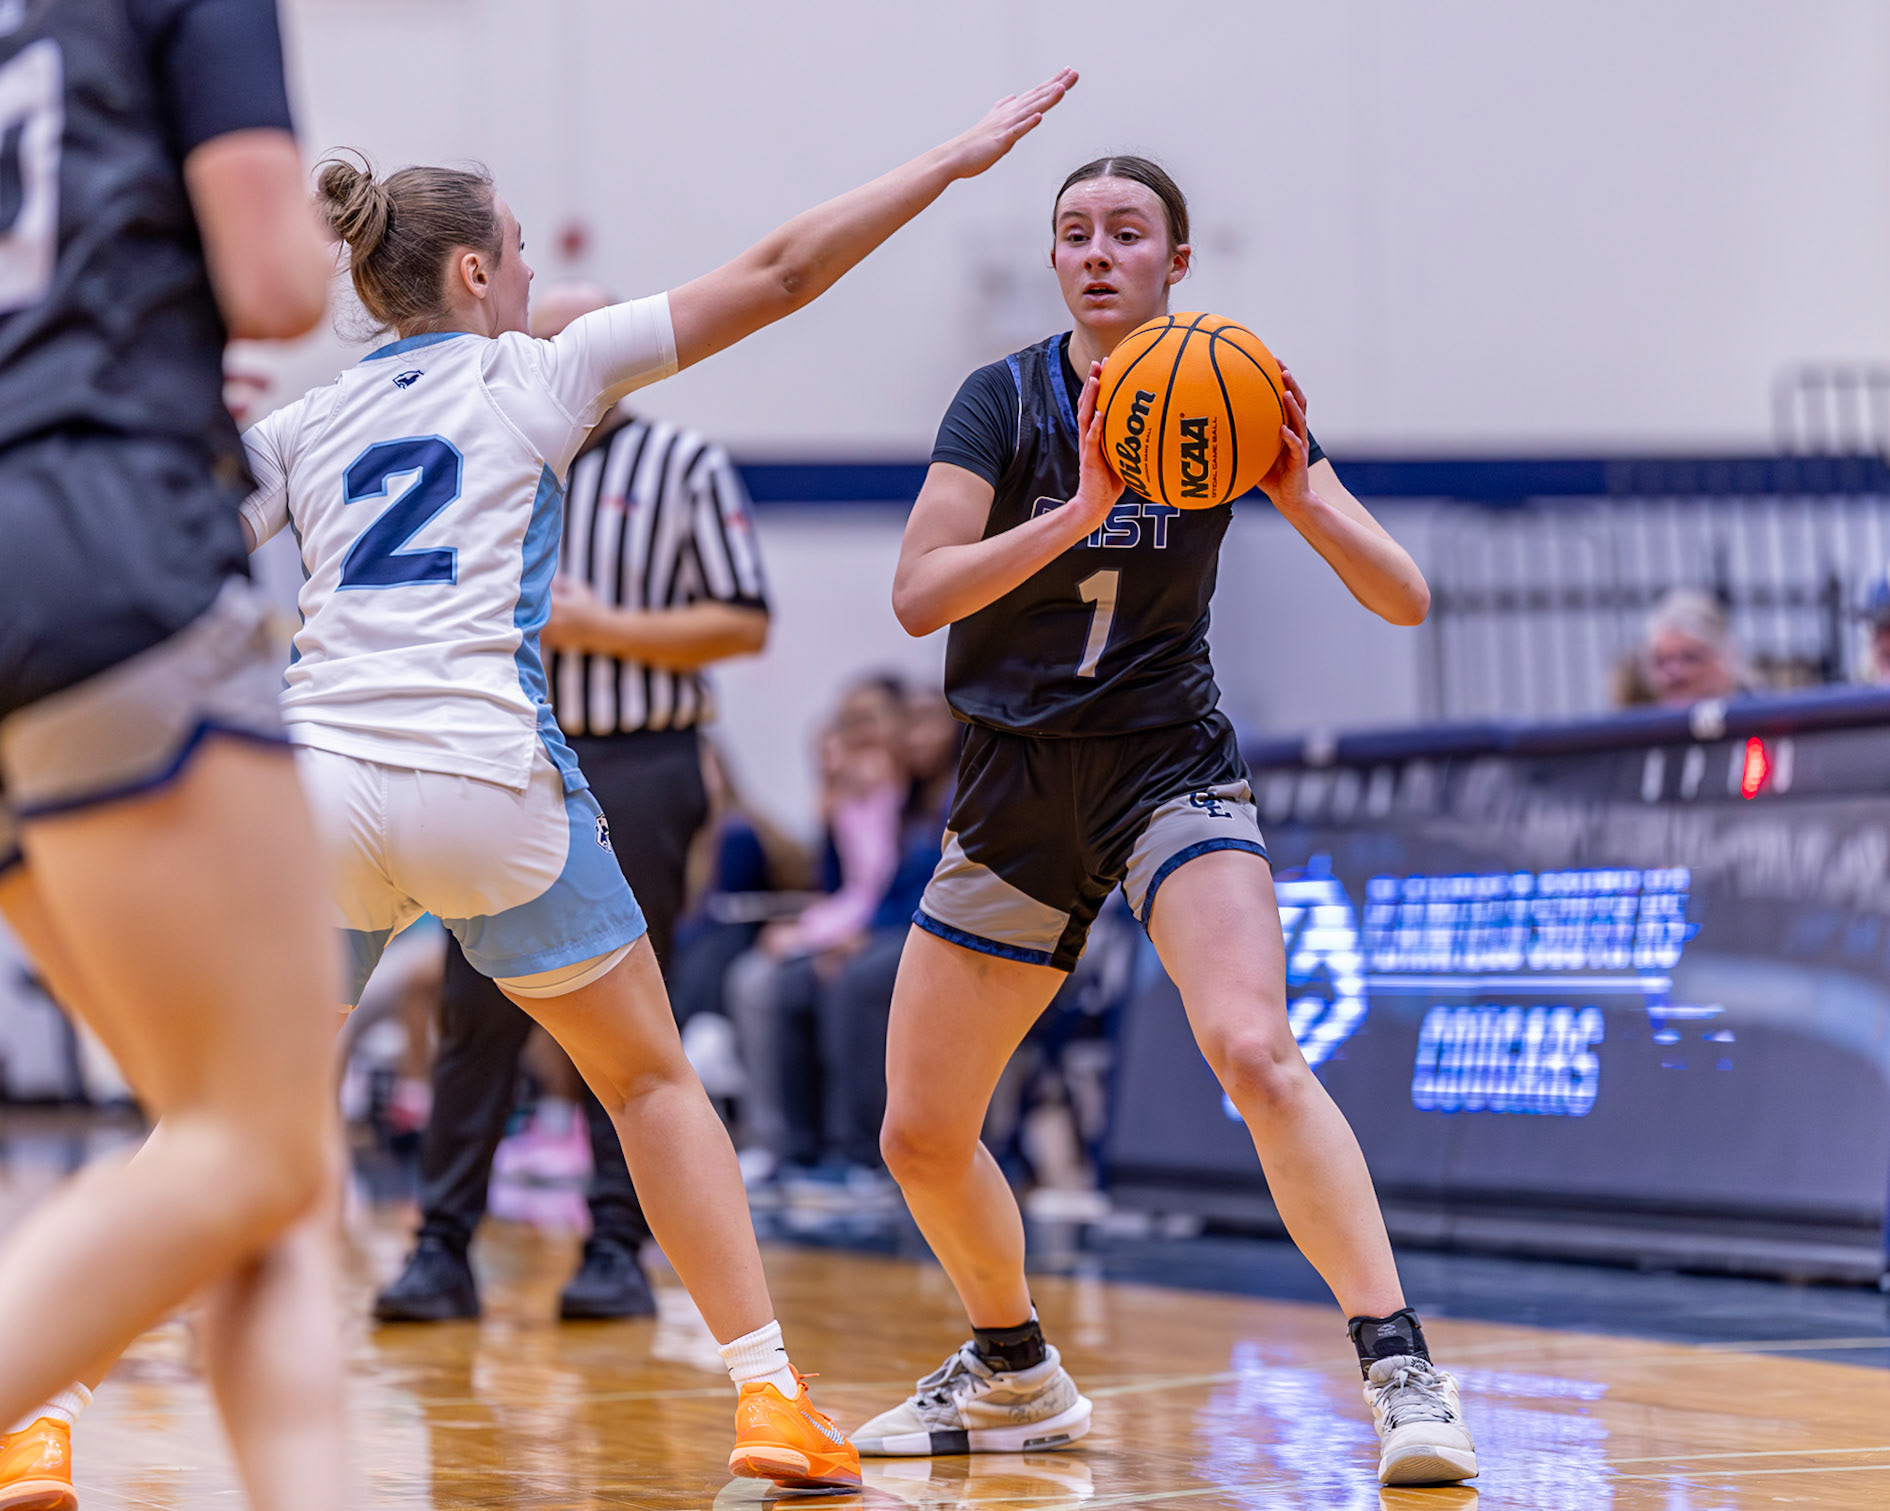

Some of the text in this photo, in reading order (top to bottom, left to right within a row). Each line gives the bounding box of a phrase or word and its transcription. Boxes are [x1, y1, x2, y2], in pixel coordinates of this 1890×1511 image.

[1180, 417, 1209, 498] NCAA
[335, 434, 464, 592] 2
[1030, 496, 1181, 549] ST
[1077, 568, 1121, 678] 1
